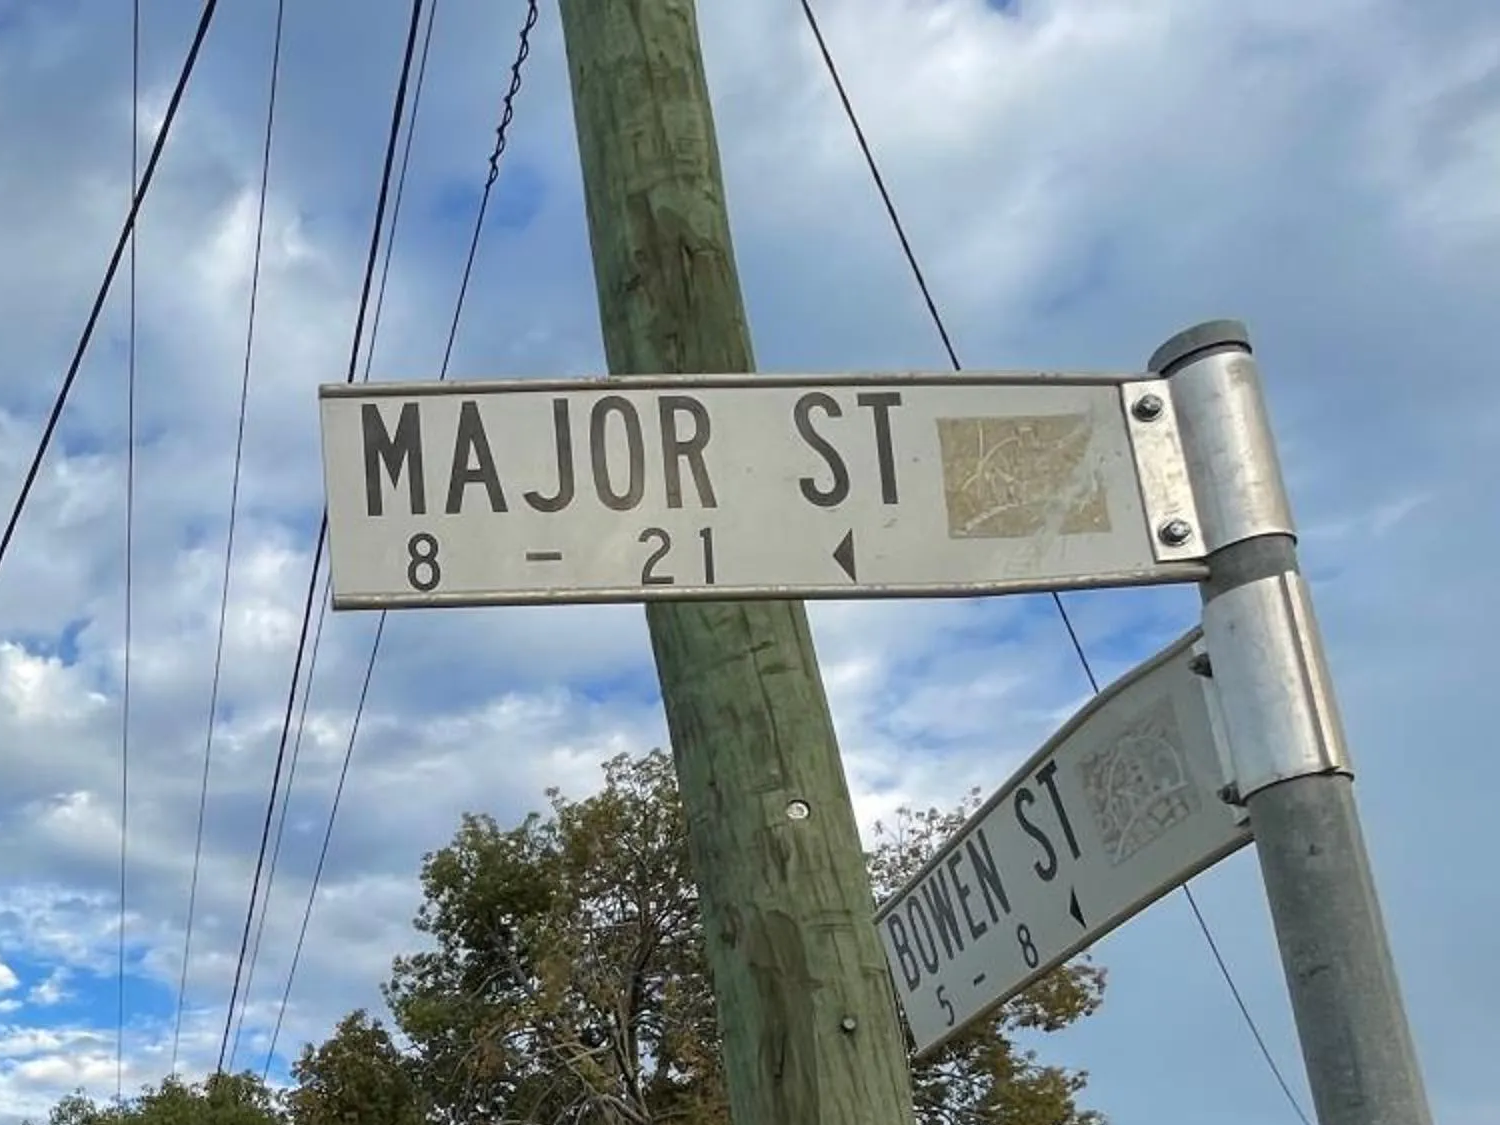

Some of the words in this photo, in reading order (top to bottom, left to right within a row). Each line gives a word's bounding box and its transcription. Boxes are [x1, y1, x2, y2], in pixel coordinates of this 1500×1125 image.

[361, 395, 717, 516] MAJOR
[794, 391, 903, 508] ST
[407, 532, 441, 594] 8
[639, 527, 715, 588] 21
[887, 828, 1011, 993] BOWEN
[1014, 760, 1081, 882] ST
[936, 984, 956, 1027] 5
[1016, 924, 1039, 970] 8
